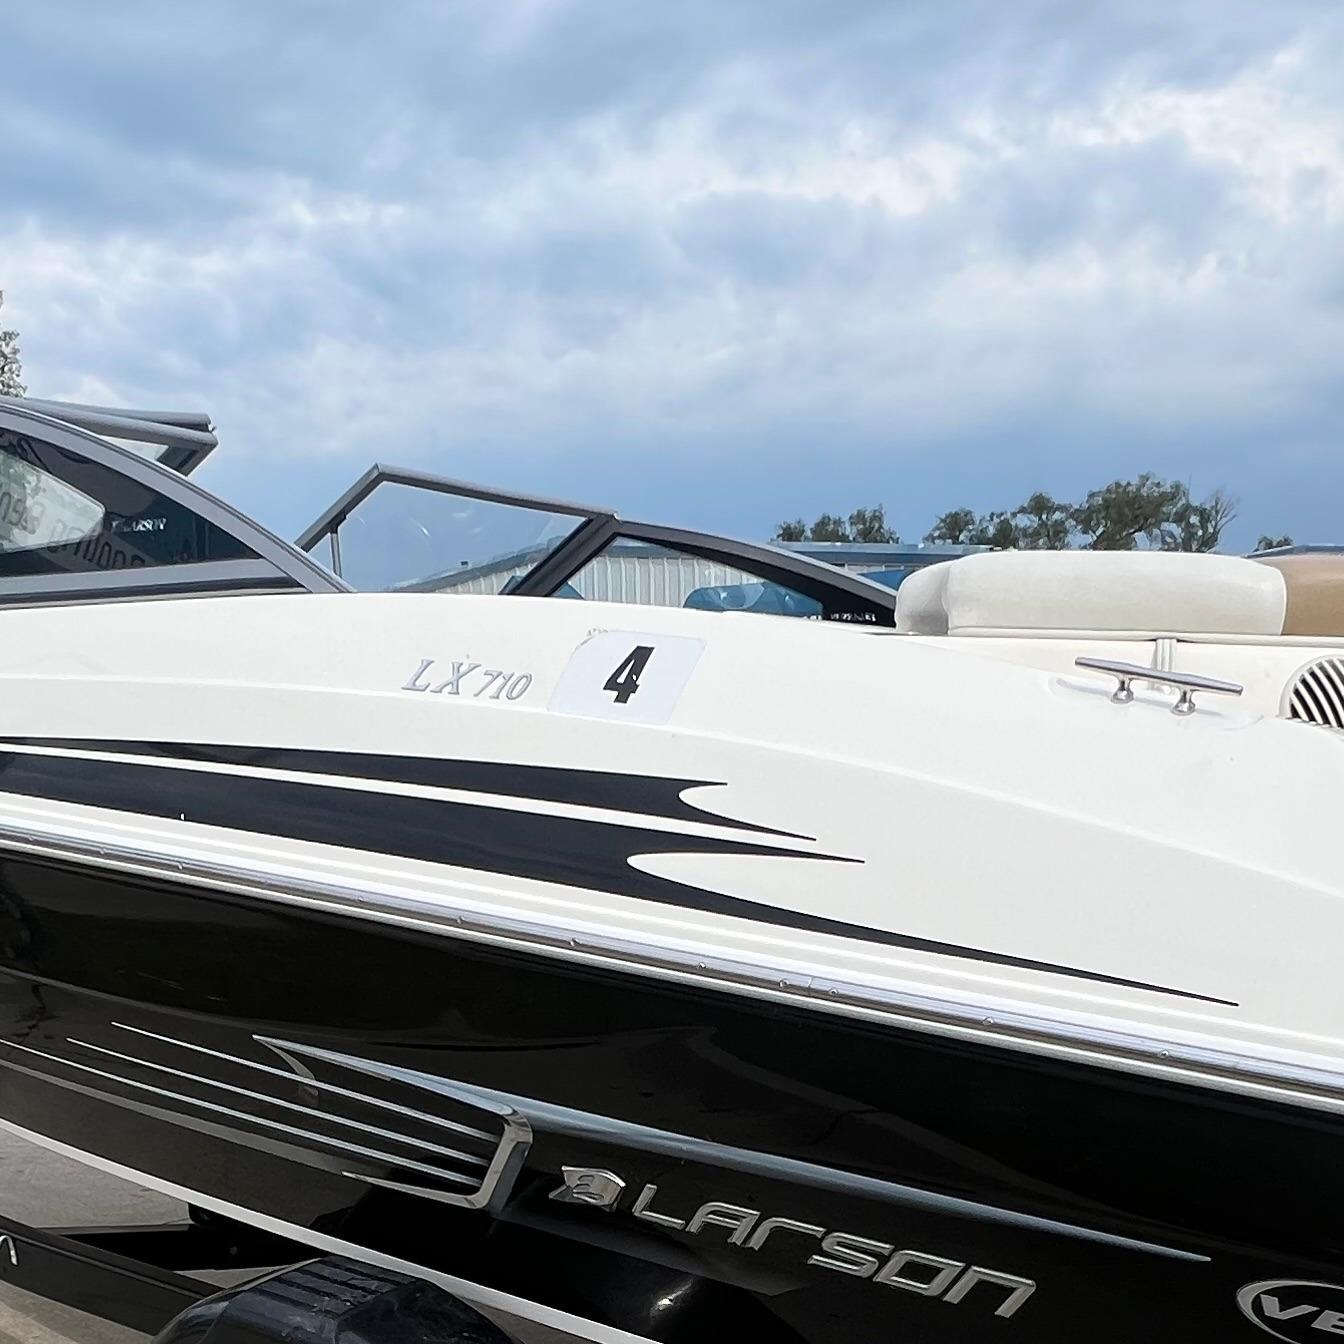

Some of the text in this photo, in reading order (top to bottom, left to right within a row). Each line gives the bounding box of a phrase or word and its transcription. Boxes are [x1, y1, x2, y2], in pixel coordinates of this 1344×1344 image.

[401, 658, 533, 701] LX 710
[603, 645, 656, 704] 4
